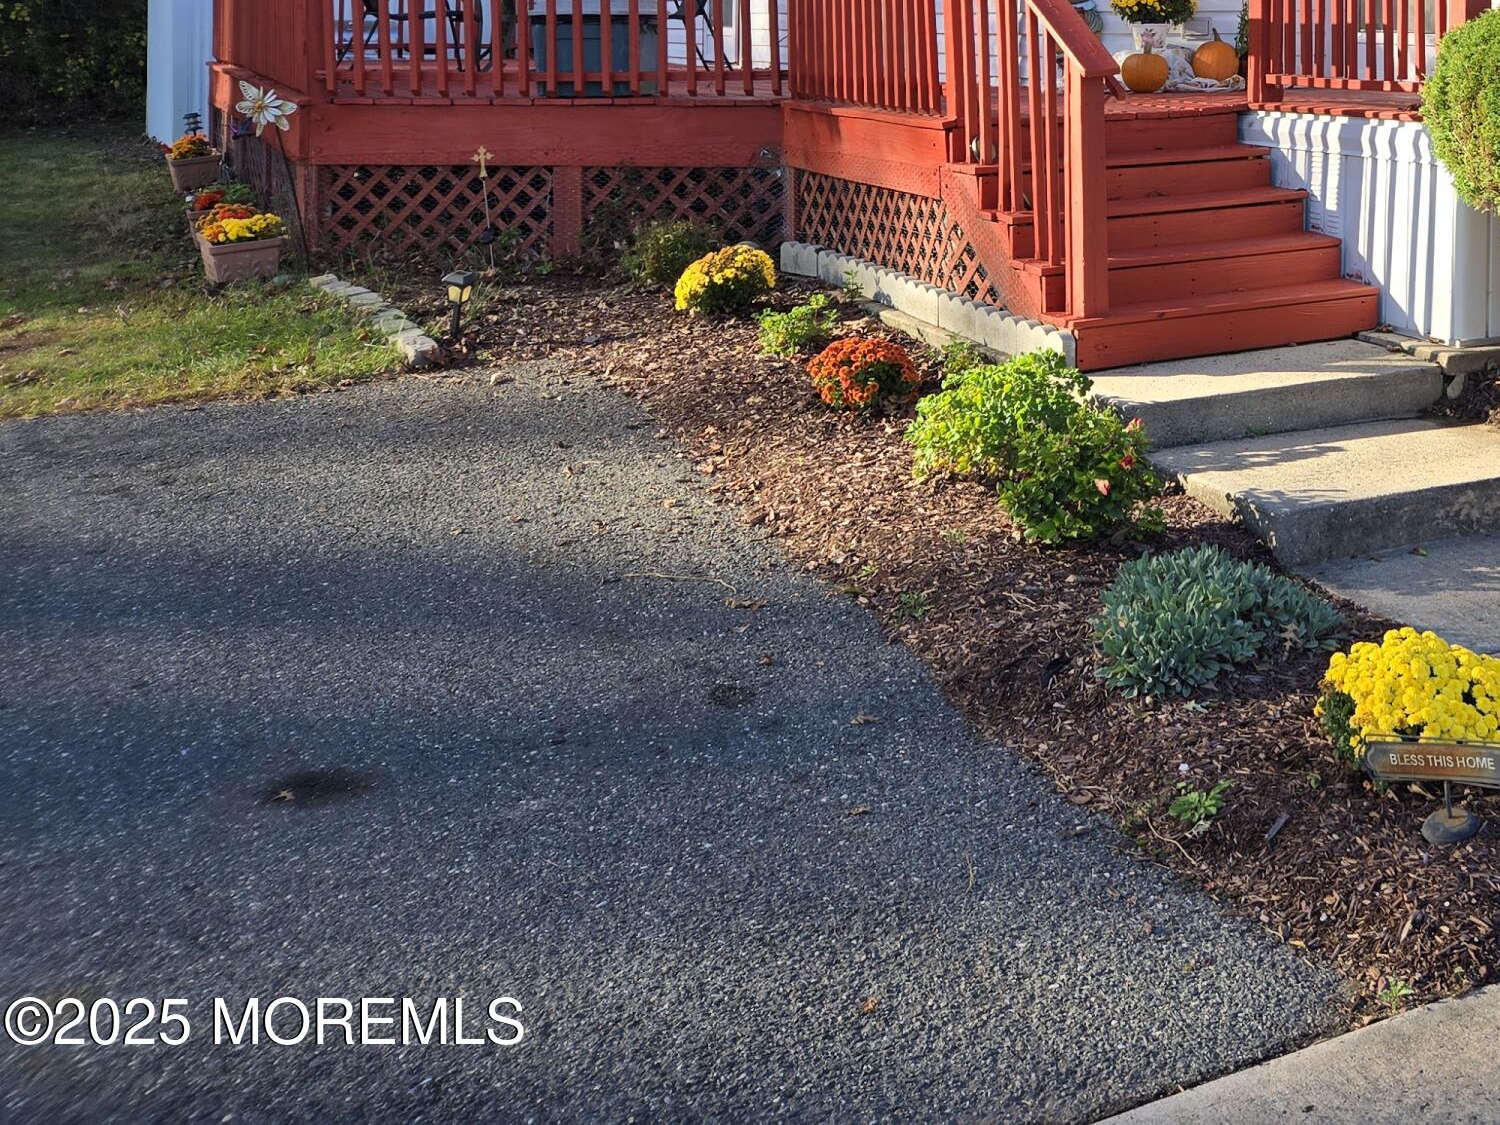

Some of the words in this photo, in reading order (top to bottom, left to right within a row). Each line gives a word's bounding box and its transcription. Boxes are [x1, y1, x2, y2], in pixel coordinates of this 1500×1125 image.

[1389, 753, 1425, 767] BLESS
[1427, 754, 1454, 768] THIS
[1456, 755, 1496, 770] HOME
